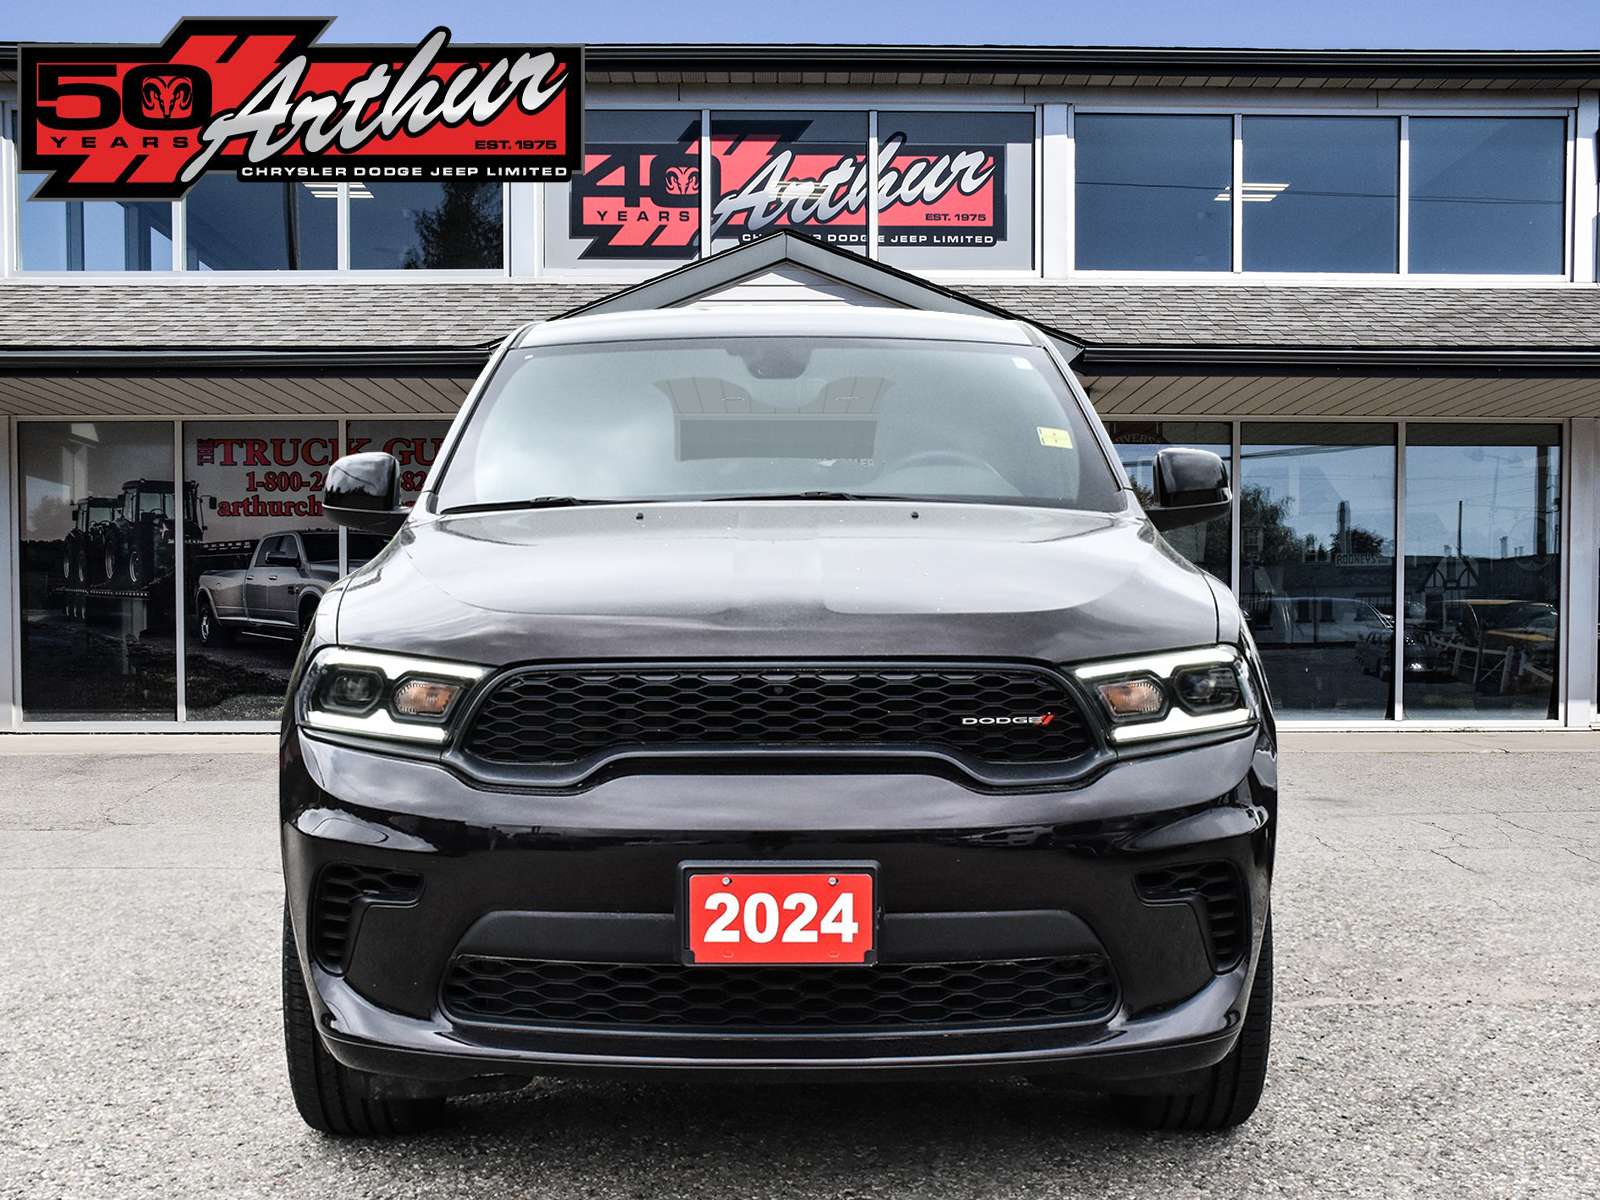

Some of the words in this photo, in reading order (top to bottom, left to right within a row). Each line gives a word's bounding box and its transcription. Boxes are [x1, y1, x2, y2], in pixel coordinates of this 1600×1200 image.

[583, 152, 721, 208] 40
[694, 134, 997, 245] Arthur
[596, 210, 691, 222] YEARS
[925, 213, 951, 222] EST.
[954, 213, 987, 222] 1975
[890, 235, 928, 243] JEEP
[933, 235, 994, 243] LIMITED
[383, 438, 445, 467] GU
[246, 471, 327, 492] 1-800-2
[217, 494, 323, 517] arthurch
[962, 716, 1043, 725] DODGE
[703, 892, 859, 943] 2024
